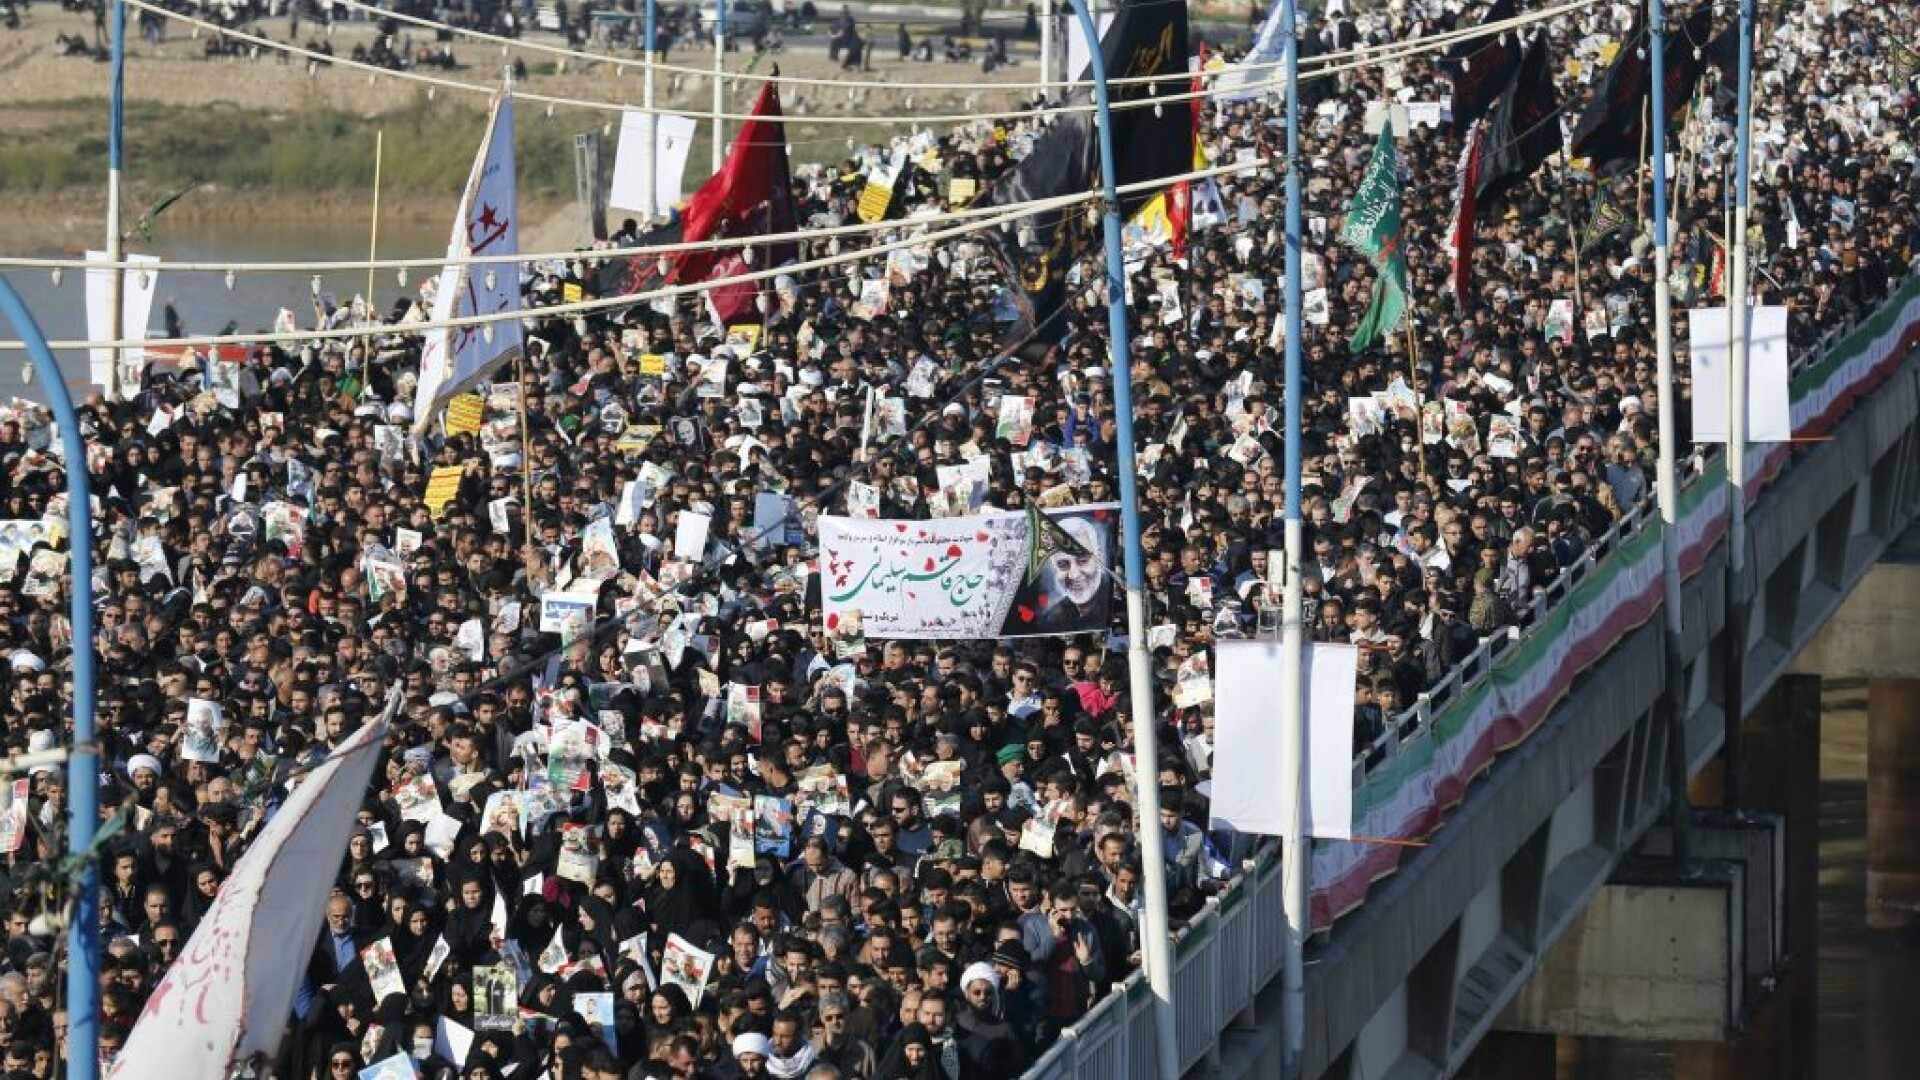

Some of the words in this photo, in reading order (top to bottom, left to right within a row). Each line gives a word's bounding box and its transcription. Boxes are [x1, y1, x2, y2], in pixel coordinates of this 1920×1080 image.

[829, 545, 907, 602] سلیمانی
[901, 555, 961, 609] قاسم
[950, 574, 984, 607] حاج
